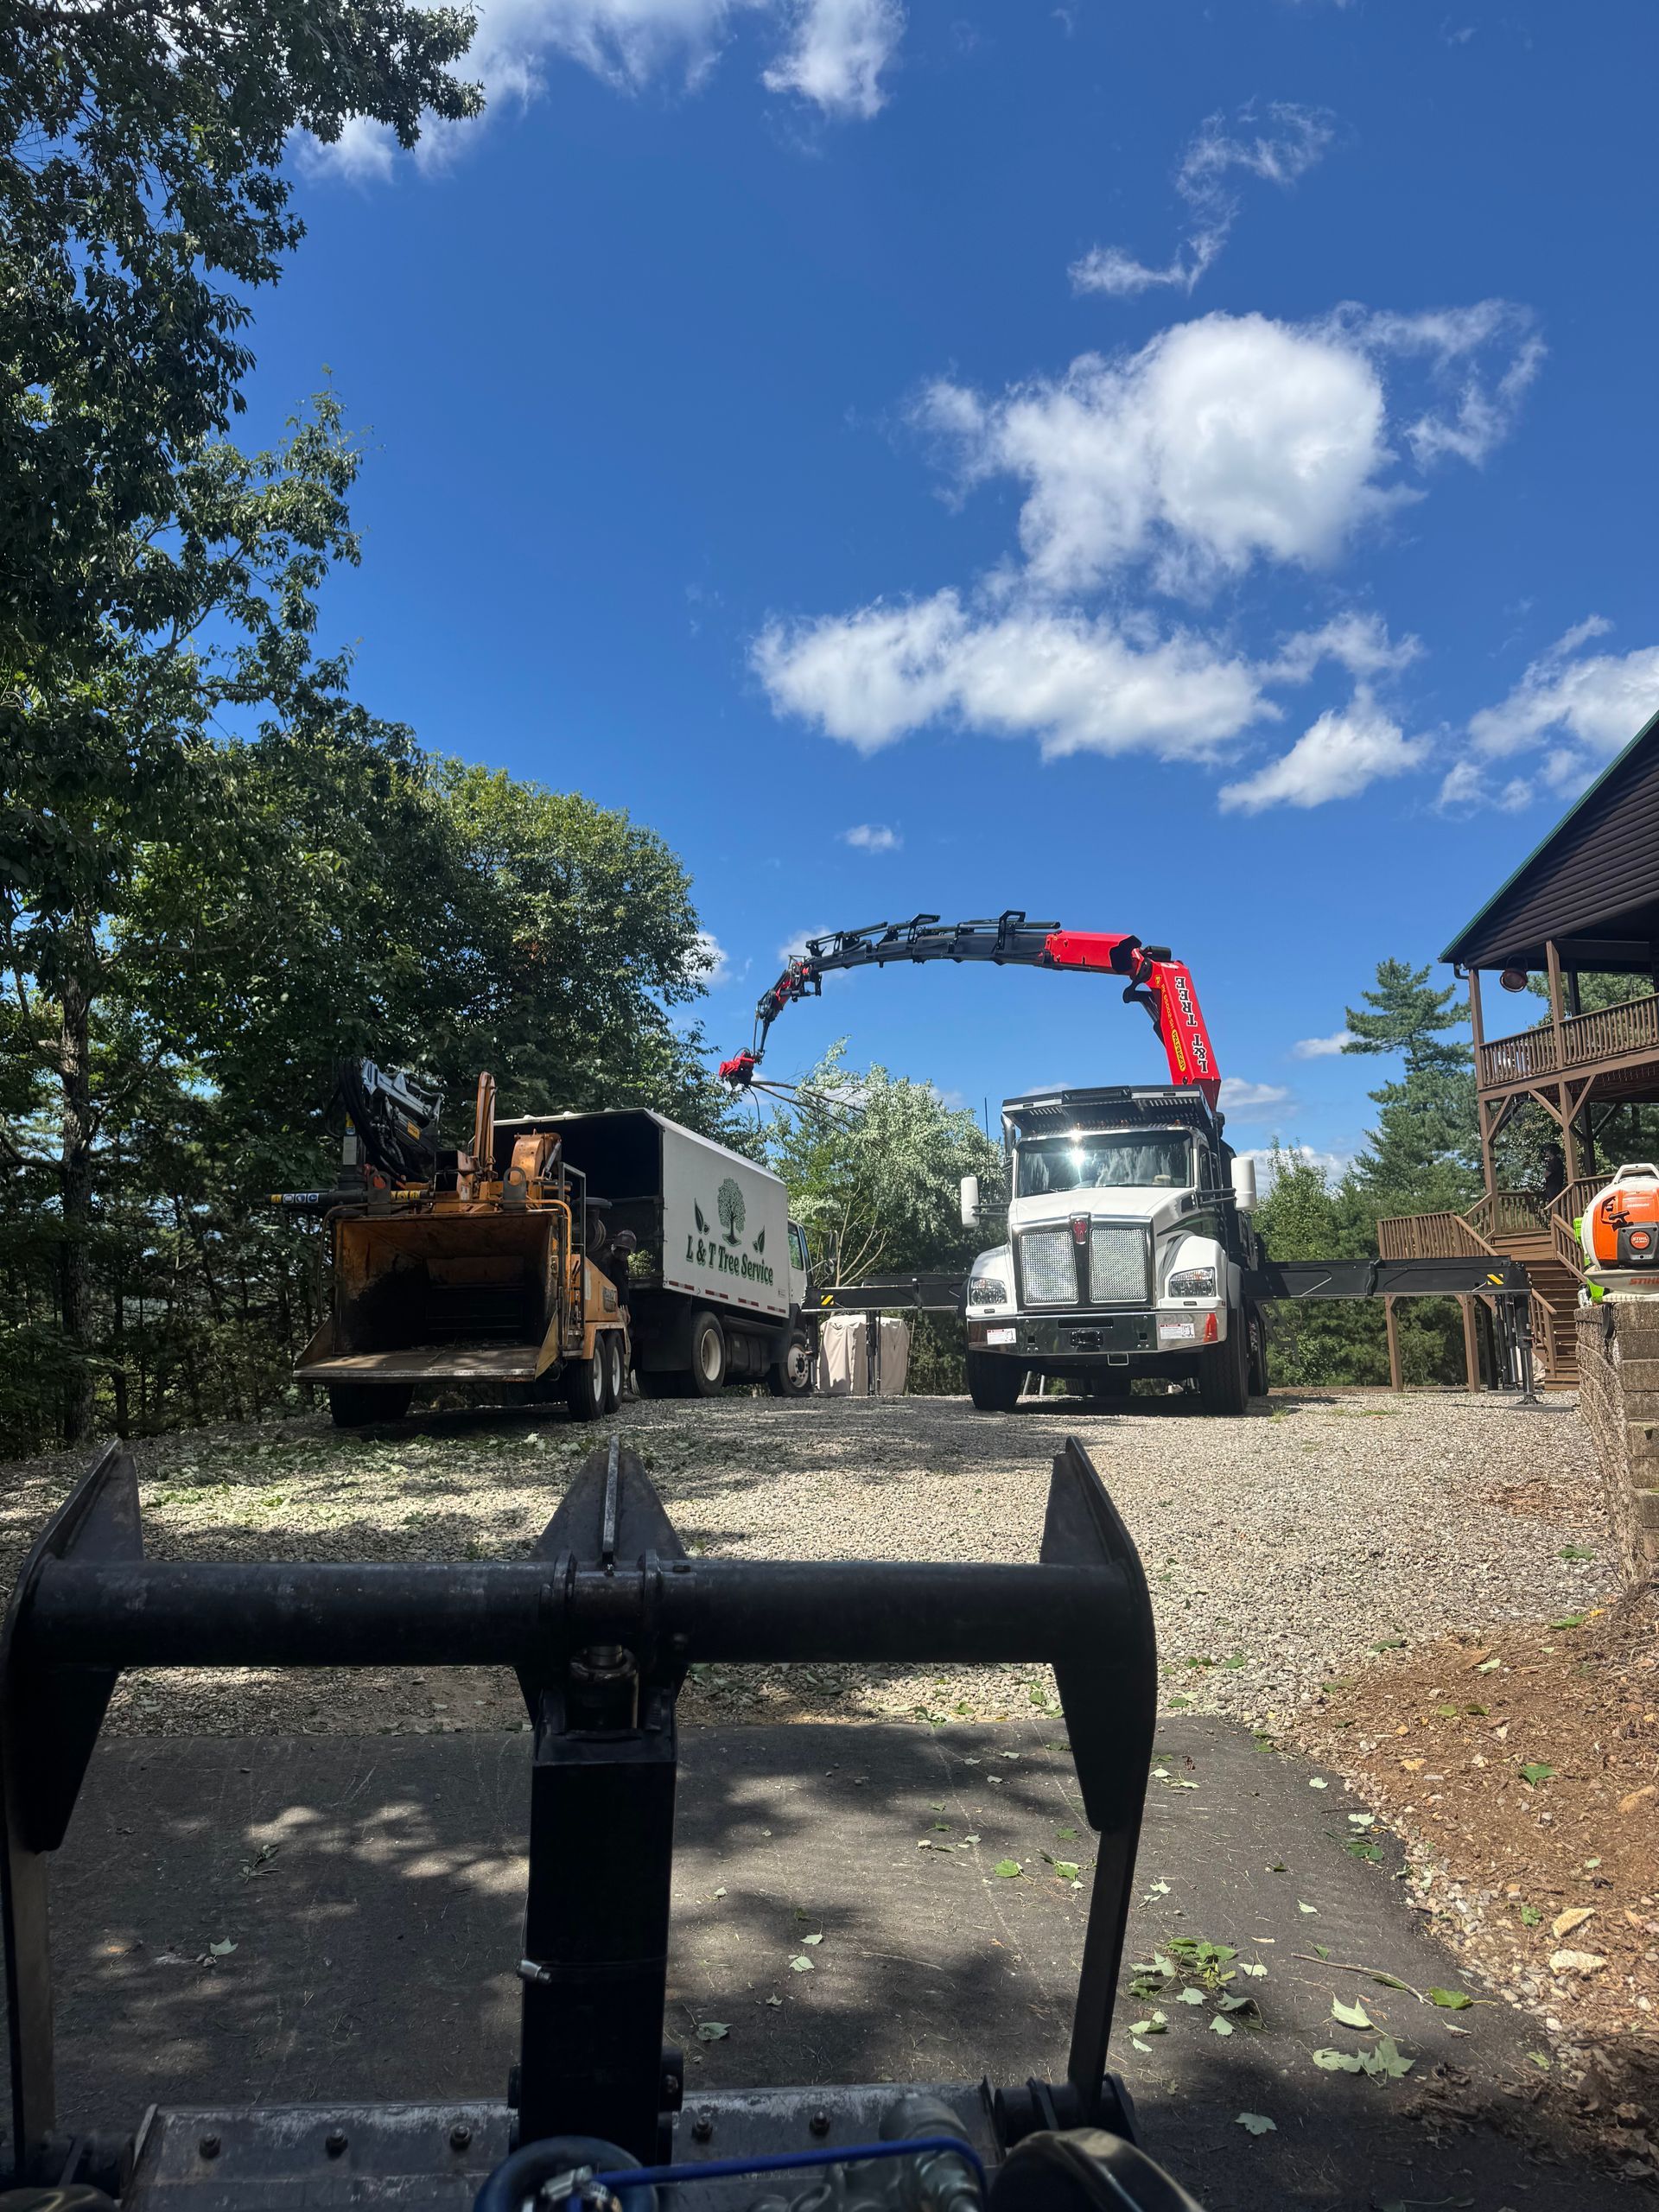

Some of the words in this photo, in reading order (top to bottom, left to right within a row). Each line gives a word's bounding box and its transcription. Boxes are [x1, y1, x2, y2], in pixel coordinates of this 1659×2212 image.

[1175, 976, 1198, 1027] TREE
[686, 1235, 694, 1263] L
[696, 1238, 707, 1267] &
[709, 1242, 716, 1268] T
[718, 1244, 740, 1276] Tree
[741, 1252, 773, 1286] Service
